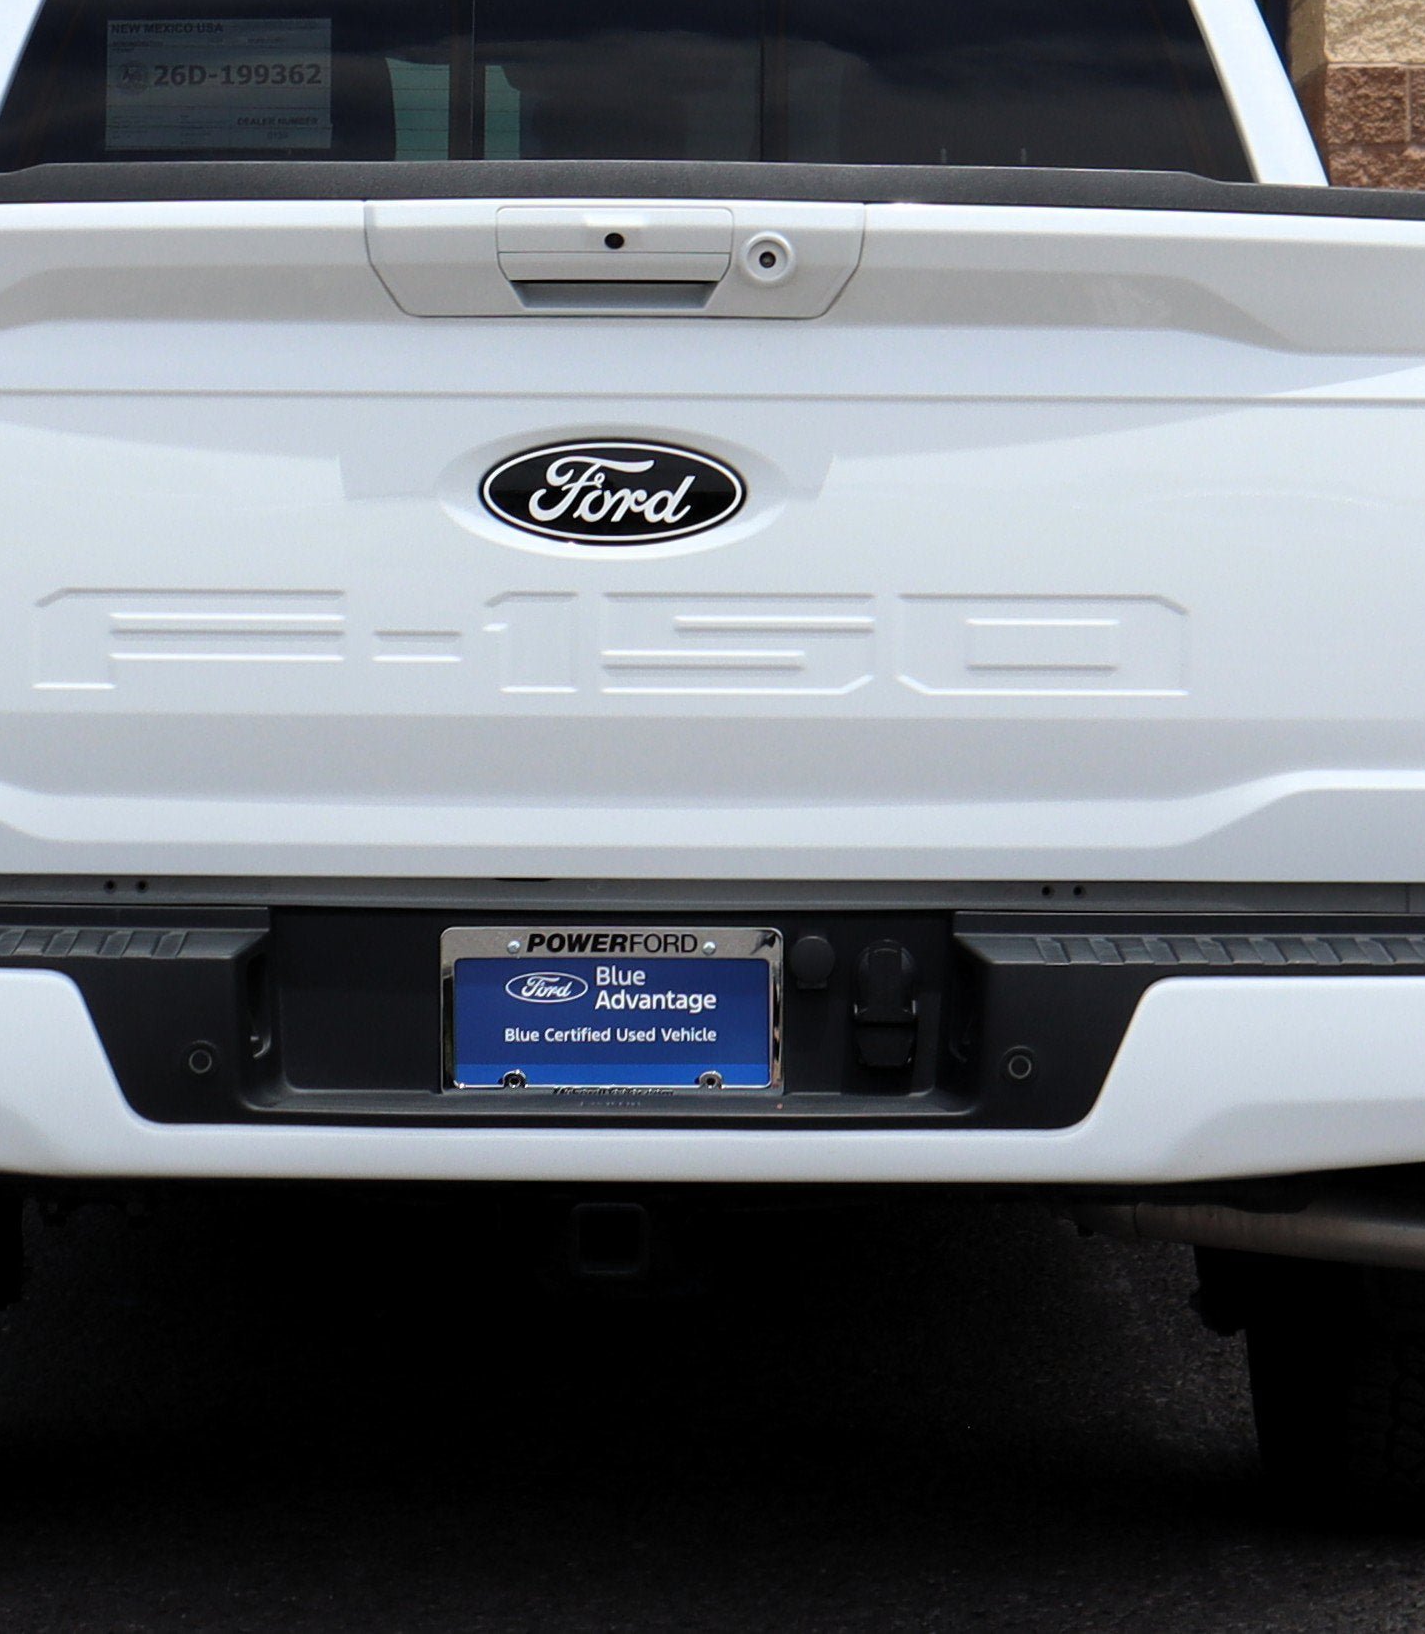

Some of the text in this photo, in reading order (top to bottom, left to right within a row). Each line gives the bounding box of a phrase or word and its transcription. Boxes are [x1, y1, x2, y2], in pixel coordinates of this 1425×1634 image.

[111, 22, 224, 35] NEW MEXICO USA
[153, 63, 322, 87] 26D-199362
[527, 454, 698, 527] Ford
[30, 586, 1191, 696] F-150
[526, 932, 699, 954] POWERFORD
[520, 974, 573, 999] Ford
[595, 965, 646, 986] Blue
[594, 989, 717, 1014] Advantage
[504, 1027, 717, 1043] Blue Certified Used Vehicle
